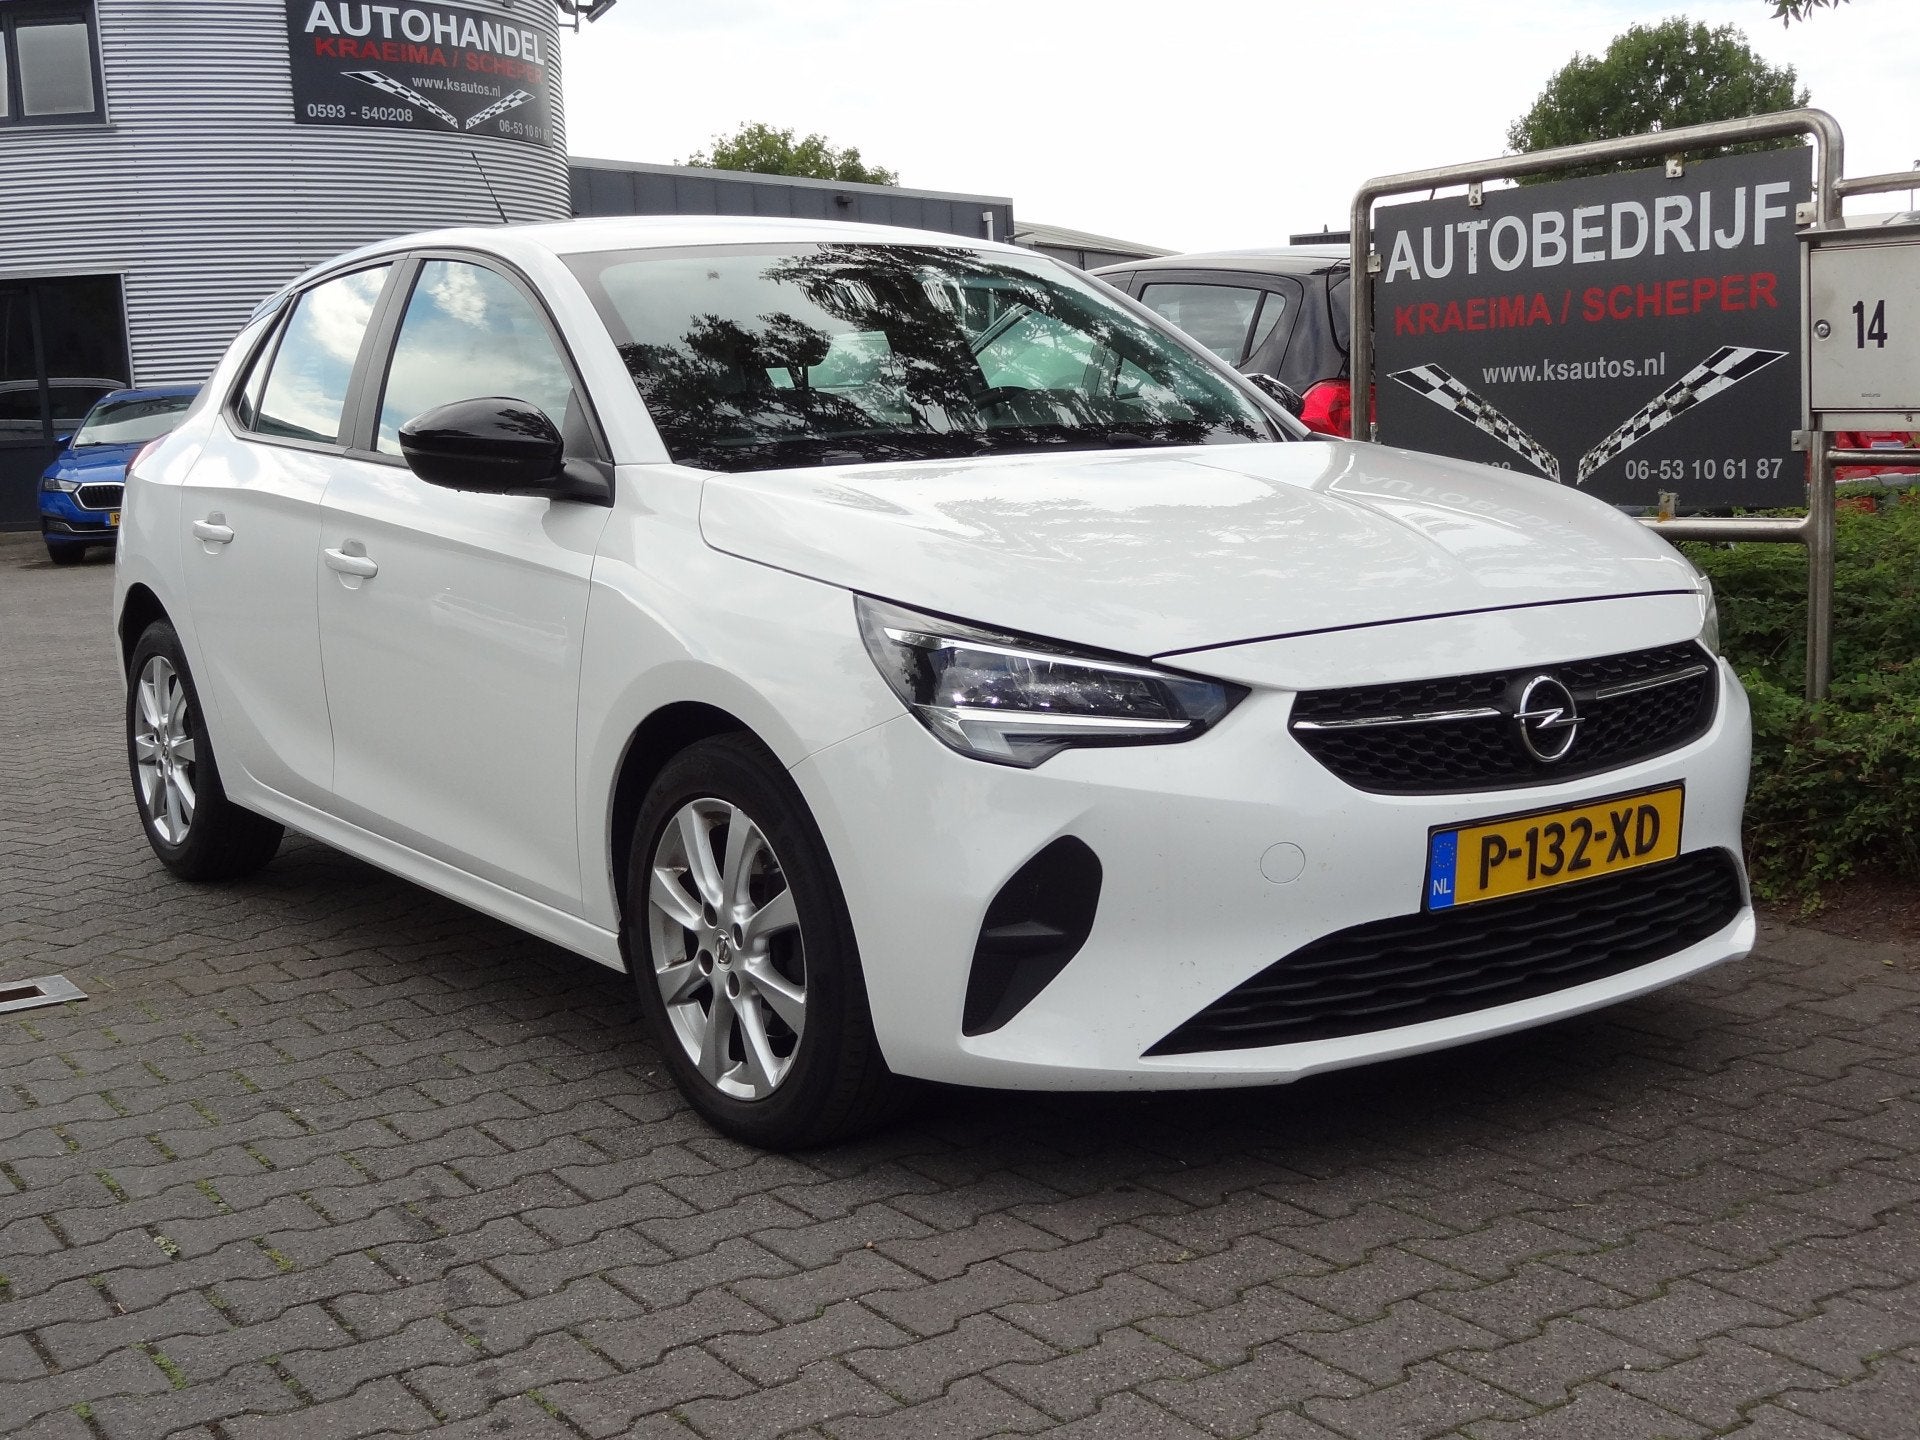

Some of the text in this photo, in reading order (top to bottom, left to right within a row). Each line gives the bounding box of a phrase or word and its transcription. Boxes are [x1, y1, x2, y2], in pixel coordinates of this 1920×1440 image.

[304, 0, 545, 66] AUTOHANDEL
[314, 36, 448, 68] KRAEIMA
[465, 50, 543, 84] SCHEPER
[412, 77, 501, 97] www.ksautos.nl
[307, 103, 346, 119] 0593
[361, 106, 413, 122] 540208
[499, 119, 523, 135] 06-53
[525, 124, 534, 137] 10
[535, 126, 542, 139] 61
[1384, 180, 1791, 285] AUTOBEDRIJF
[1395, 292, 1552, 337] KRAEIMA
[1582, 271, 1780, 323] SCHEPER
[1852, 299, 1888, 349] 14
[1482, 352, 1666, 384] www.ksautos.nl
[1625, 457, 1783, 480] 06-53 10 61 87
[1479, 804, 1661, 890] P-132-XD
[1433, 878, 1451, 896] NL
